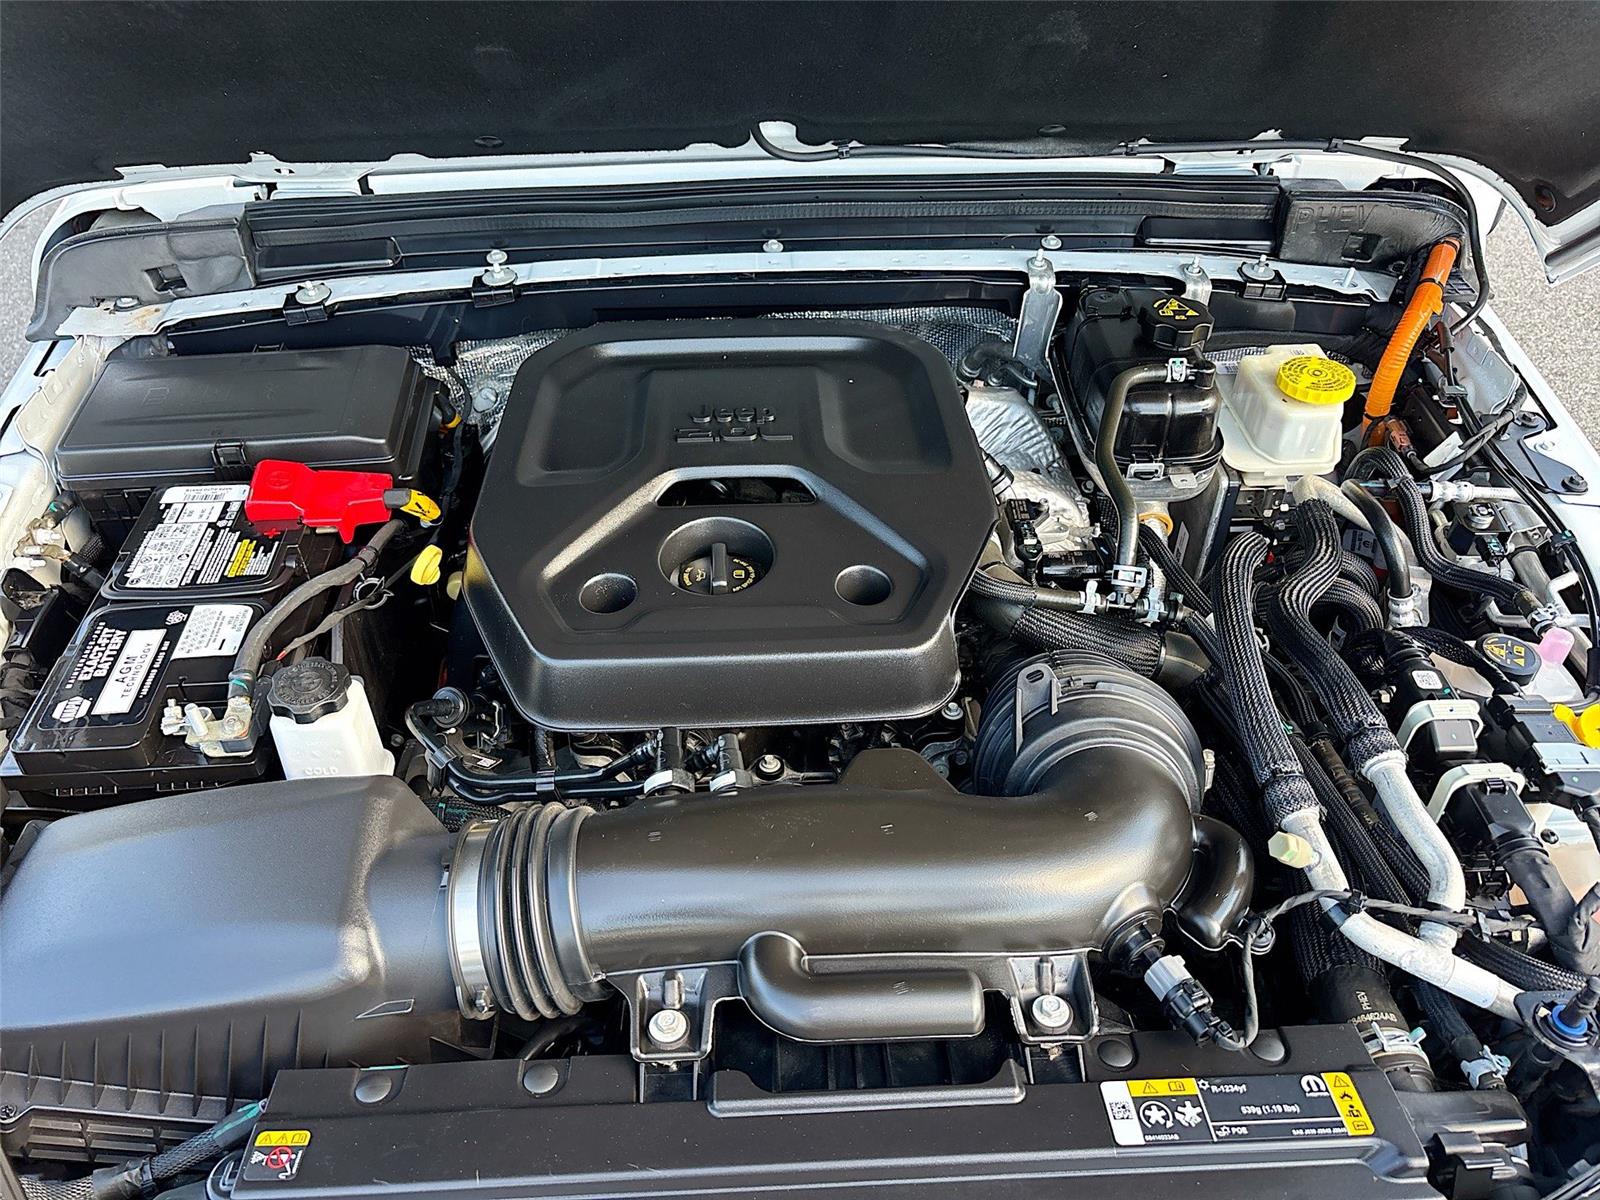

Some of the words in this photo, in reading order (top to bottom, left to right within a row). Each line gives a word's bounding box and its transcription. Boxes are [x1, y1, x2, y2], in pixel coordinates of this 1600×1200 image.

[1292, 204, 1378, 234] PHEV
[689, 404, 775, 425] Jeep
[674, 427, 793, 443] 2.0L
[77, 627, 116, 681] EXACT-FIT
[93, 629, 127, 677] BATTERY
[115, 655, 138, 683] AGM
[120, 643, 153, 698] TECHNOLOGY
[304, 766, 339, 776] COLD
[1356, 991, 1372, 1010] PHEV
[1210, 1083, 1247, 1095] R-1234yf
